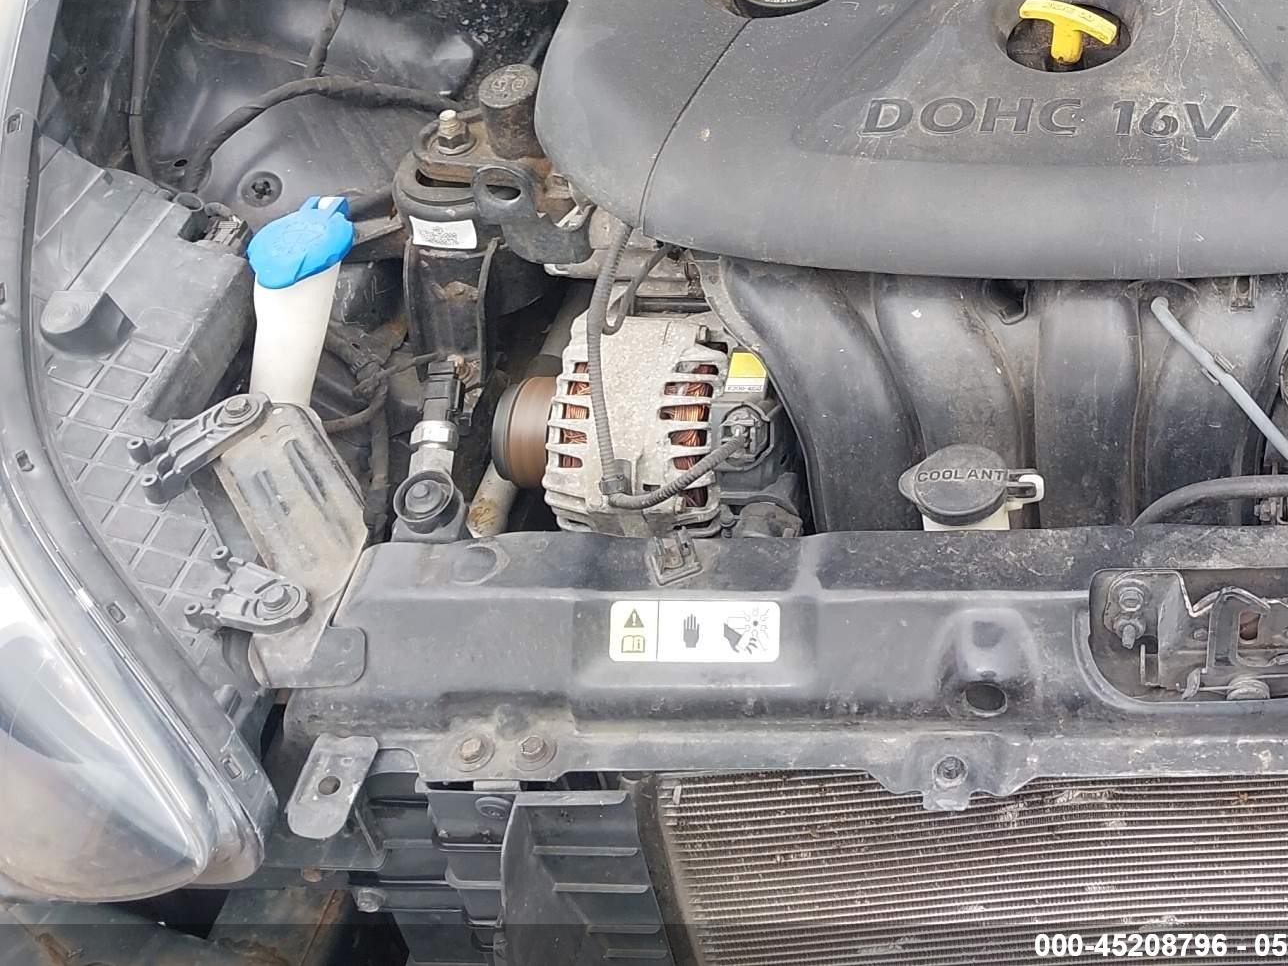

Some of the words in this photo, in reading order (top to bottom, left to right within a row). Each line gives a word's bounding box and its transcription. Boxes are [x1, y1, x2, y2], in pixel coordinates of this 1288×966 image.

[861, 96, 1083, 137] DOHC
[1111, 99, 1239, 141] 16V
[917, 468, 1006, 483] COOLANT
